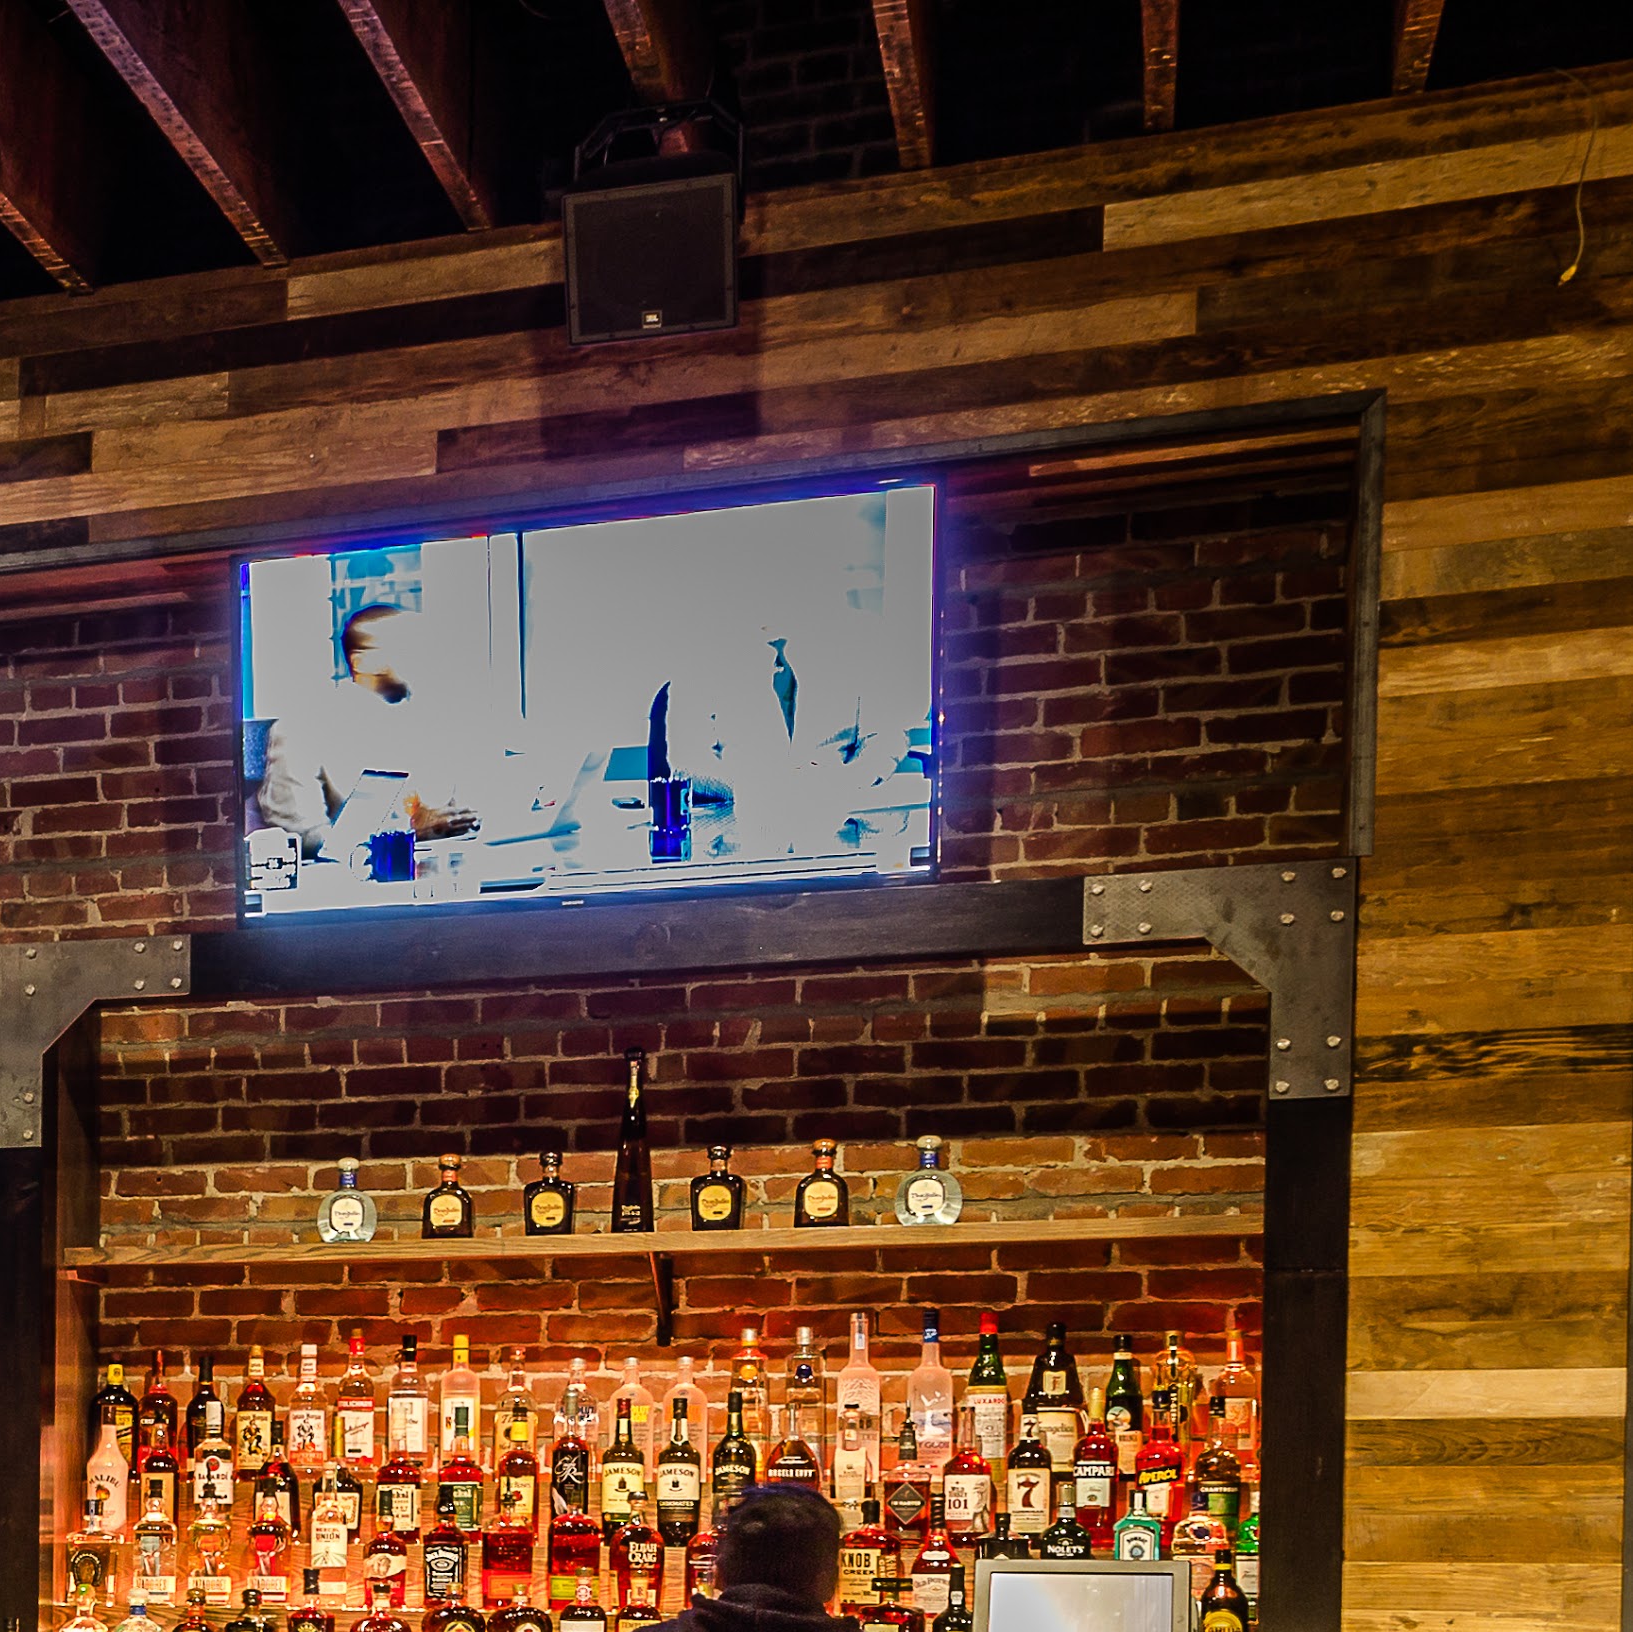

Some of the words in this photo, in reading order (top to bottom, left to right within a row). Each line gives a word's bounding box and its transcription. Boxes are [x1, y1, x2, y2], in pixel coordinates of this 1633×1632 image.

[973, 1397, 1006, 1405] LUXARDO
[1023, 1419, 1036, 1438] 7
[604, 1467, 642, 1478] JAMESON
[659, 1468, 695, 1478] JAMESON
[715, 1465, 751, 1476] JAMESON
[1073, 1466, 1115, 1478] CAMPARI
[1138, 1469, 1178, 1484] APEROL
[88, 1474, 121, 1488] MALIBU
[1017, 1476, 1040, 1508] 7
[948, 1498, 969, 1510] 101
[628, 1541, 658, 1553] ELIJAH
[627, 1552, 658, 1564] CRAIG
[842, 1552, 872, 1568] KNOB
